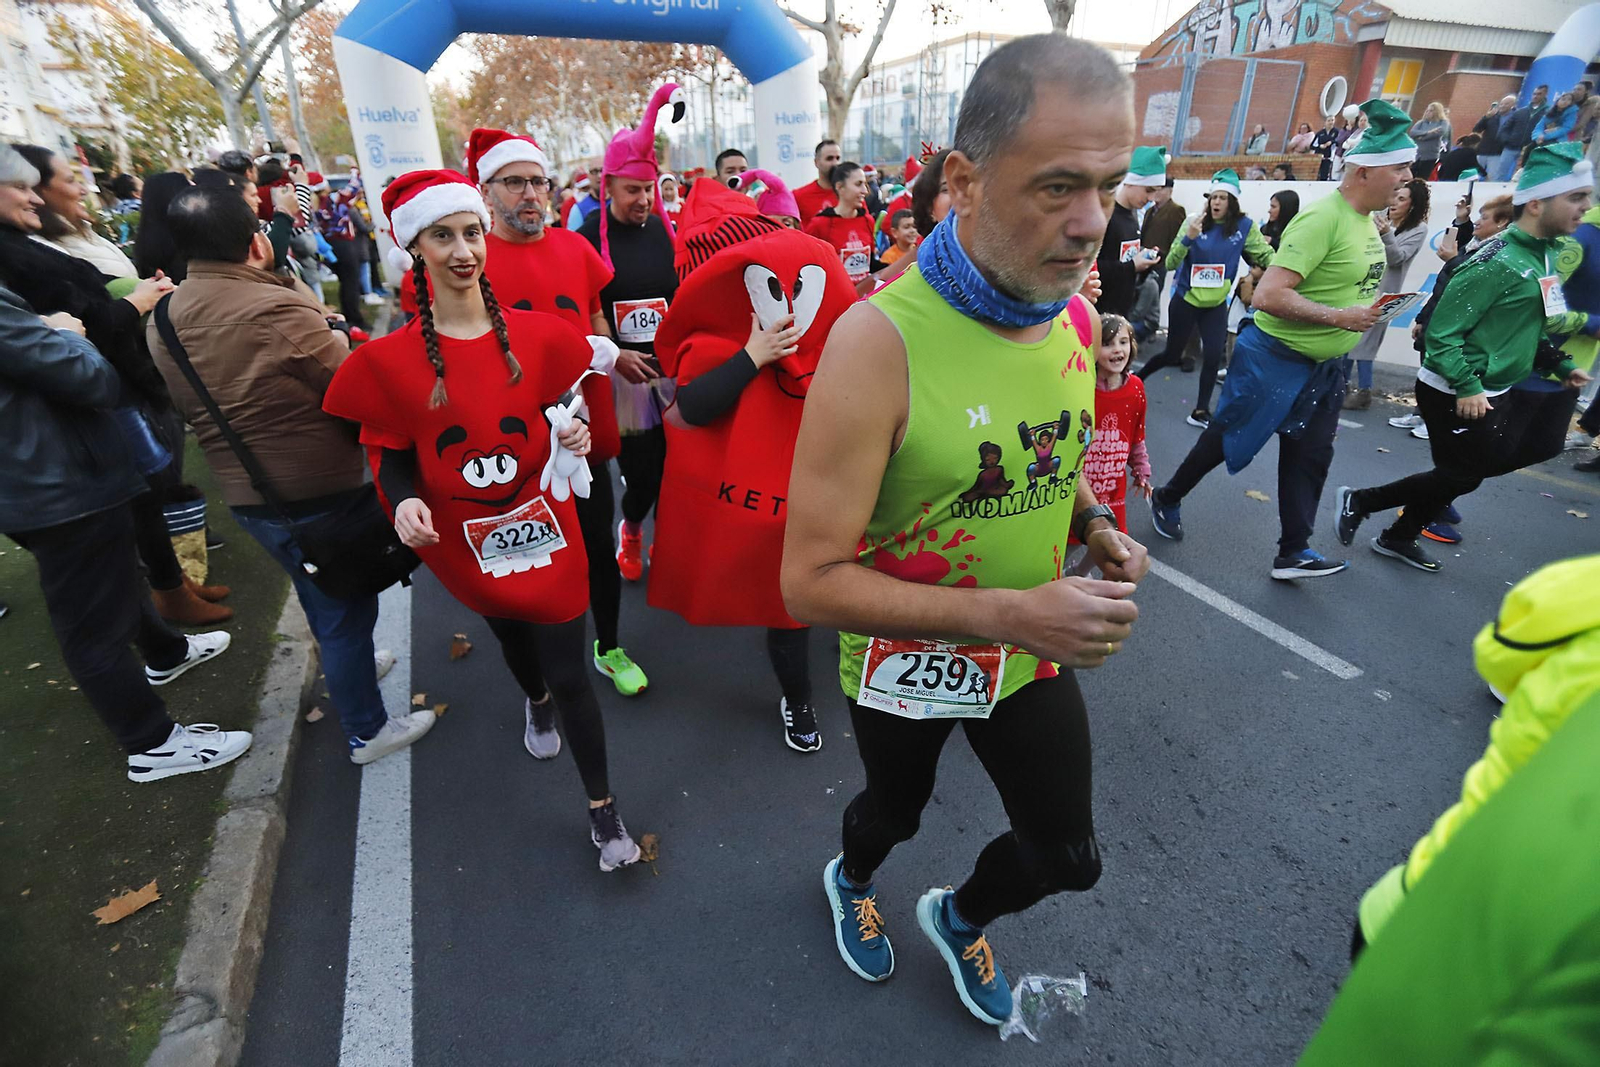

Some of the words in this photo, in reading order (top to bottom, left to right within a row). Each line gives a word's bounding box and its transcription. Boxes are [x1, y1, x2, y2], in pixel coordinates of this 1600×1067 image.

[1200, 271, 1216, 280] 563
[630, 311, 657, 329] 184
[718, 481, 786, 516] KET
[491, 522, 538, 550] 322
[896, 653, 968, 692] 259
[898, 687, 914, 696] JOSE
[915, 689, 936, 698] MIGUEL
